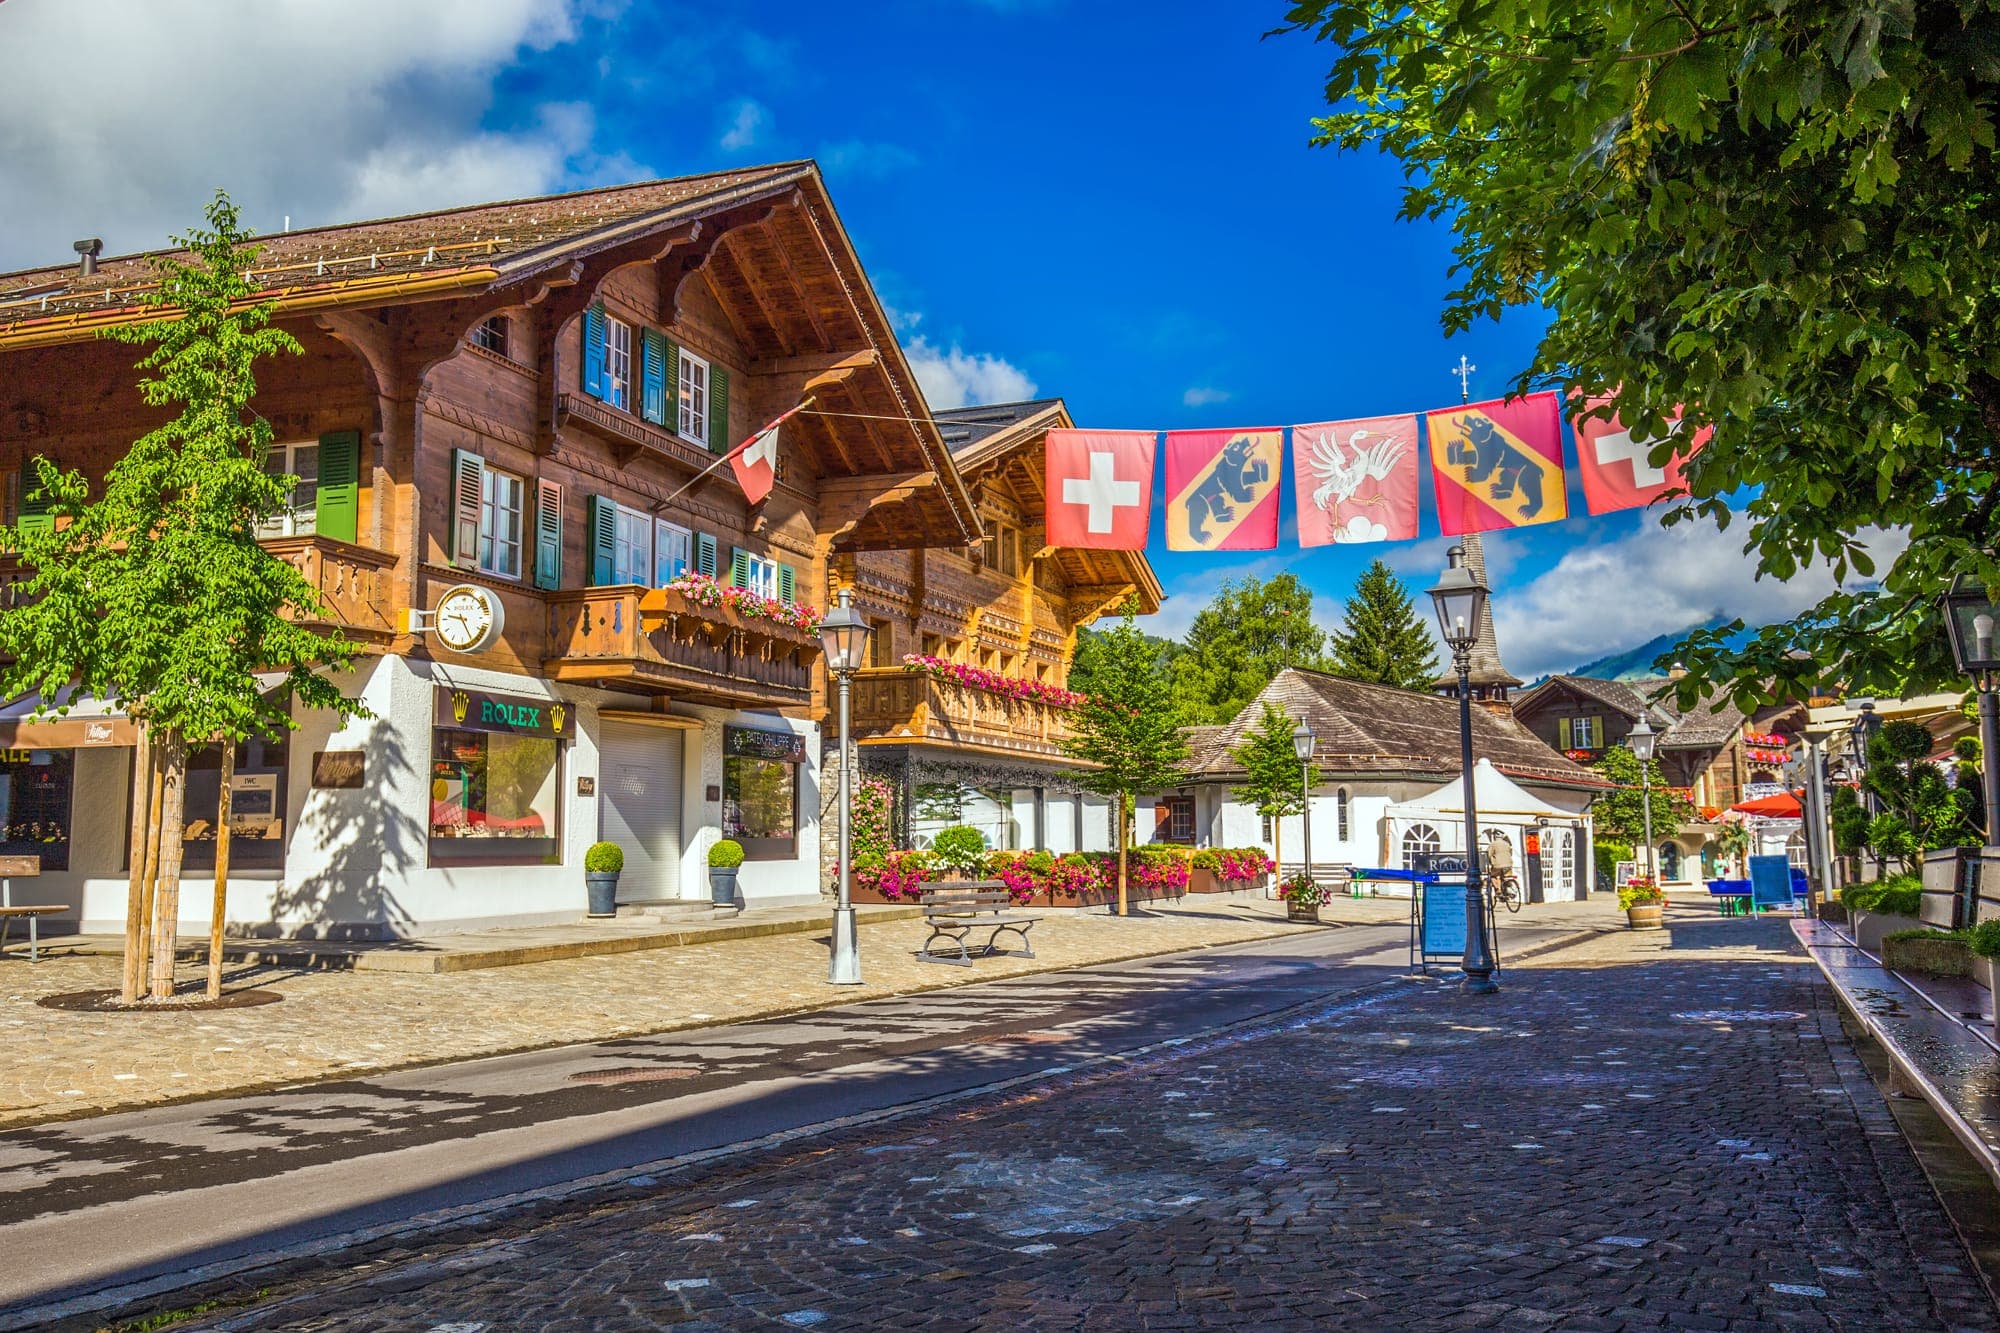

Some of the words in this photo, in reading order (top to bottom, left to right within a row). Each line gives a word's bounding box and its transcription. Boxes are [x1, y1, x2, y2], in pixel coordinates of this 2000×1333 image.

[481, 700, 540, 728] ROLEX
[746, 731, 765, 745] PATEK
[765, 733, 789, 748] PHILIPPE
[244, 777, 257, 785] IWC
[1430, 859, 1469, 871] RIALTO
